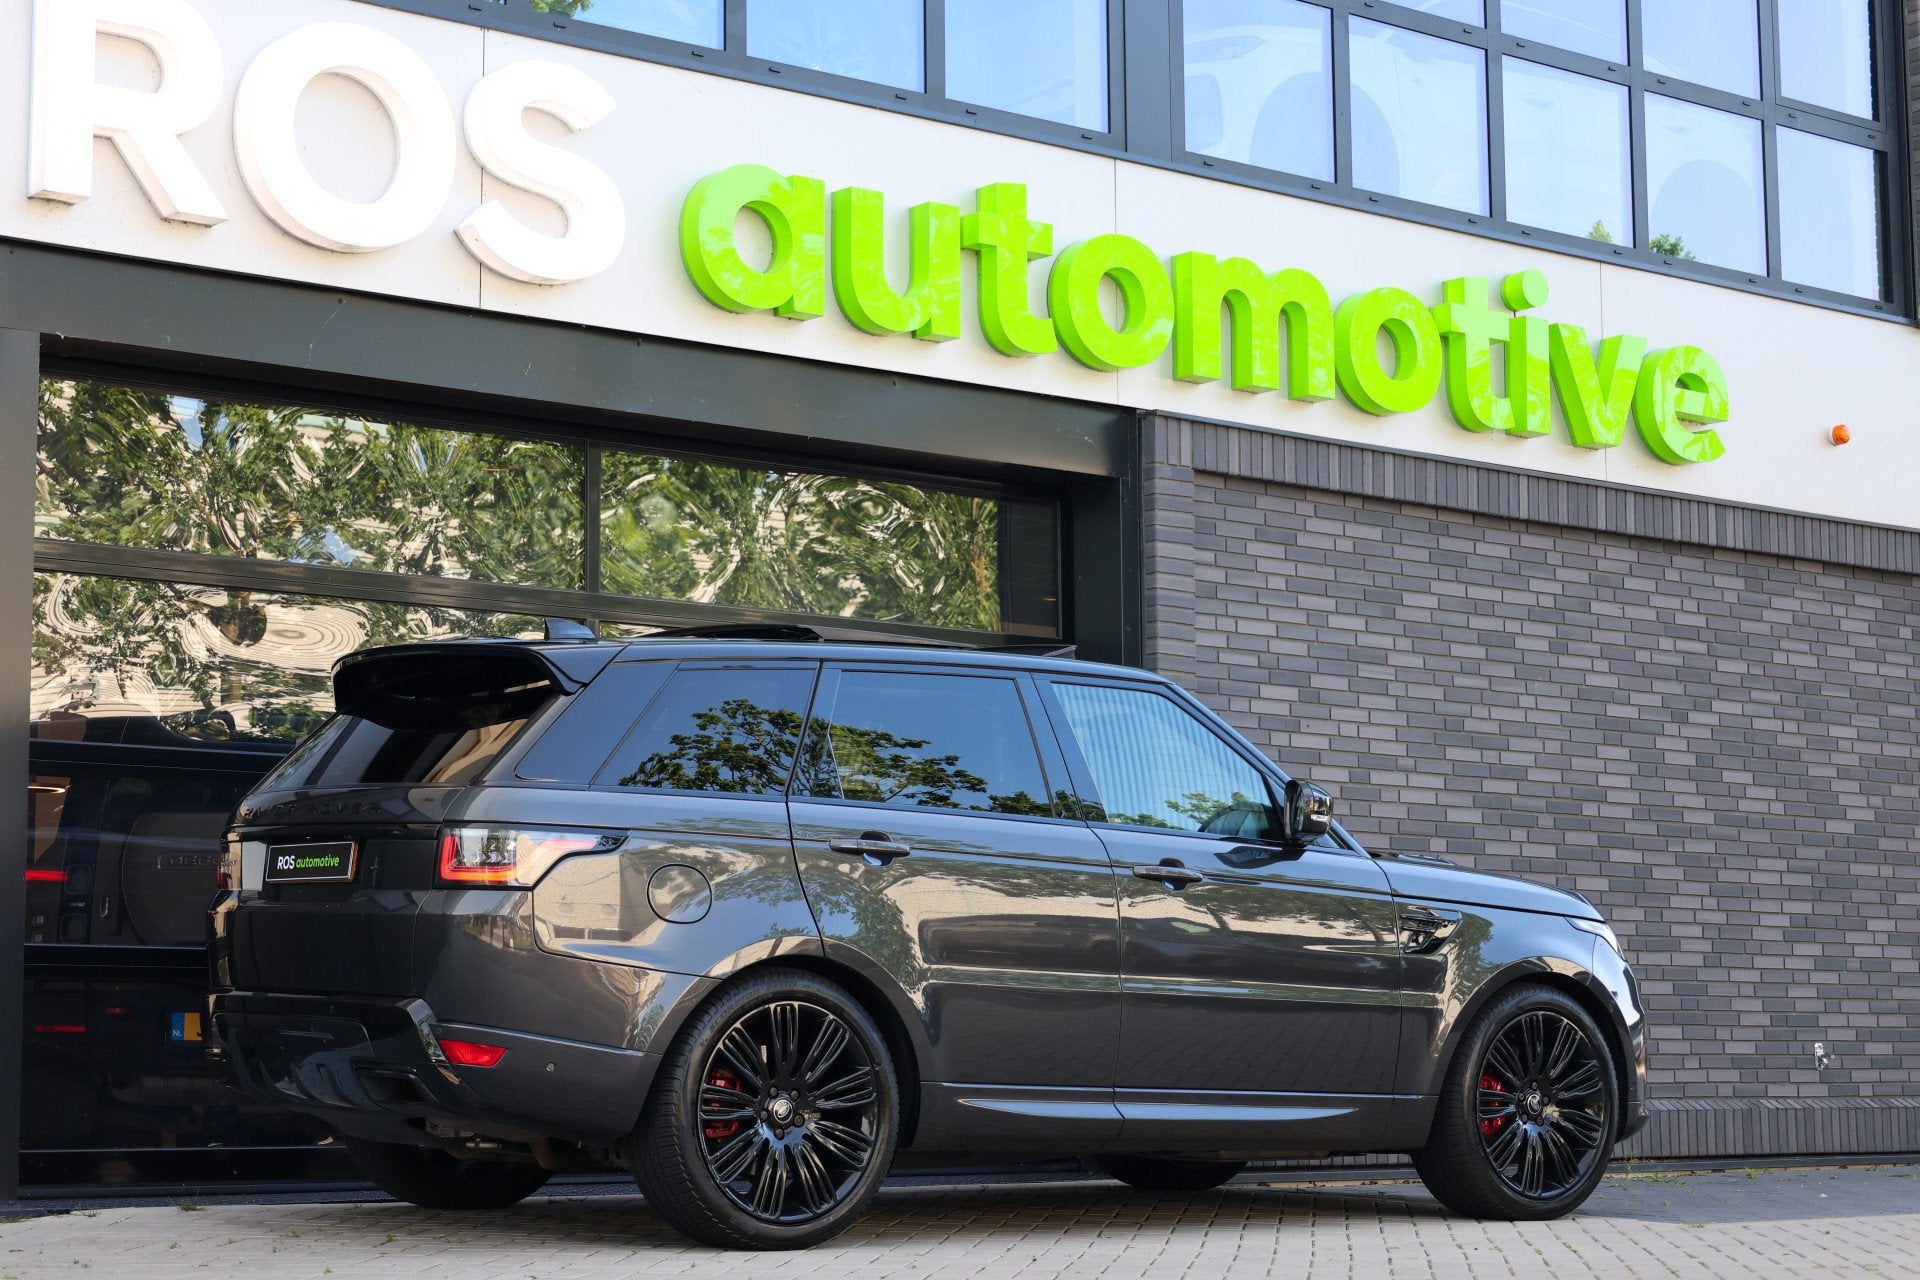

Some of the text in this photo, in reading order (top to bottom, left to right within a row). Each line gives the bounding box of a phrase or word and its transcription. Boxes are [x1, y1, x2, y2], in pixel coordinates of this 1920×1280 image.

[27, 0, 1729, 465] ROS automotive
[277, 854, 340, 870] ROS automotive
